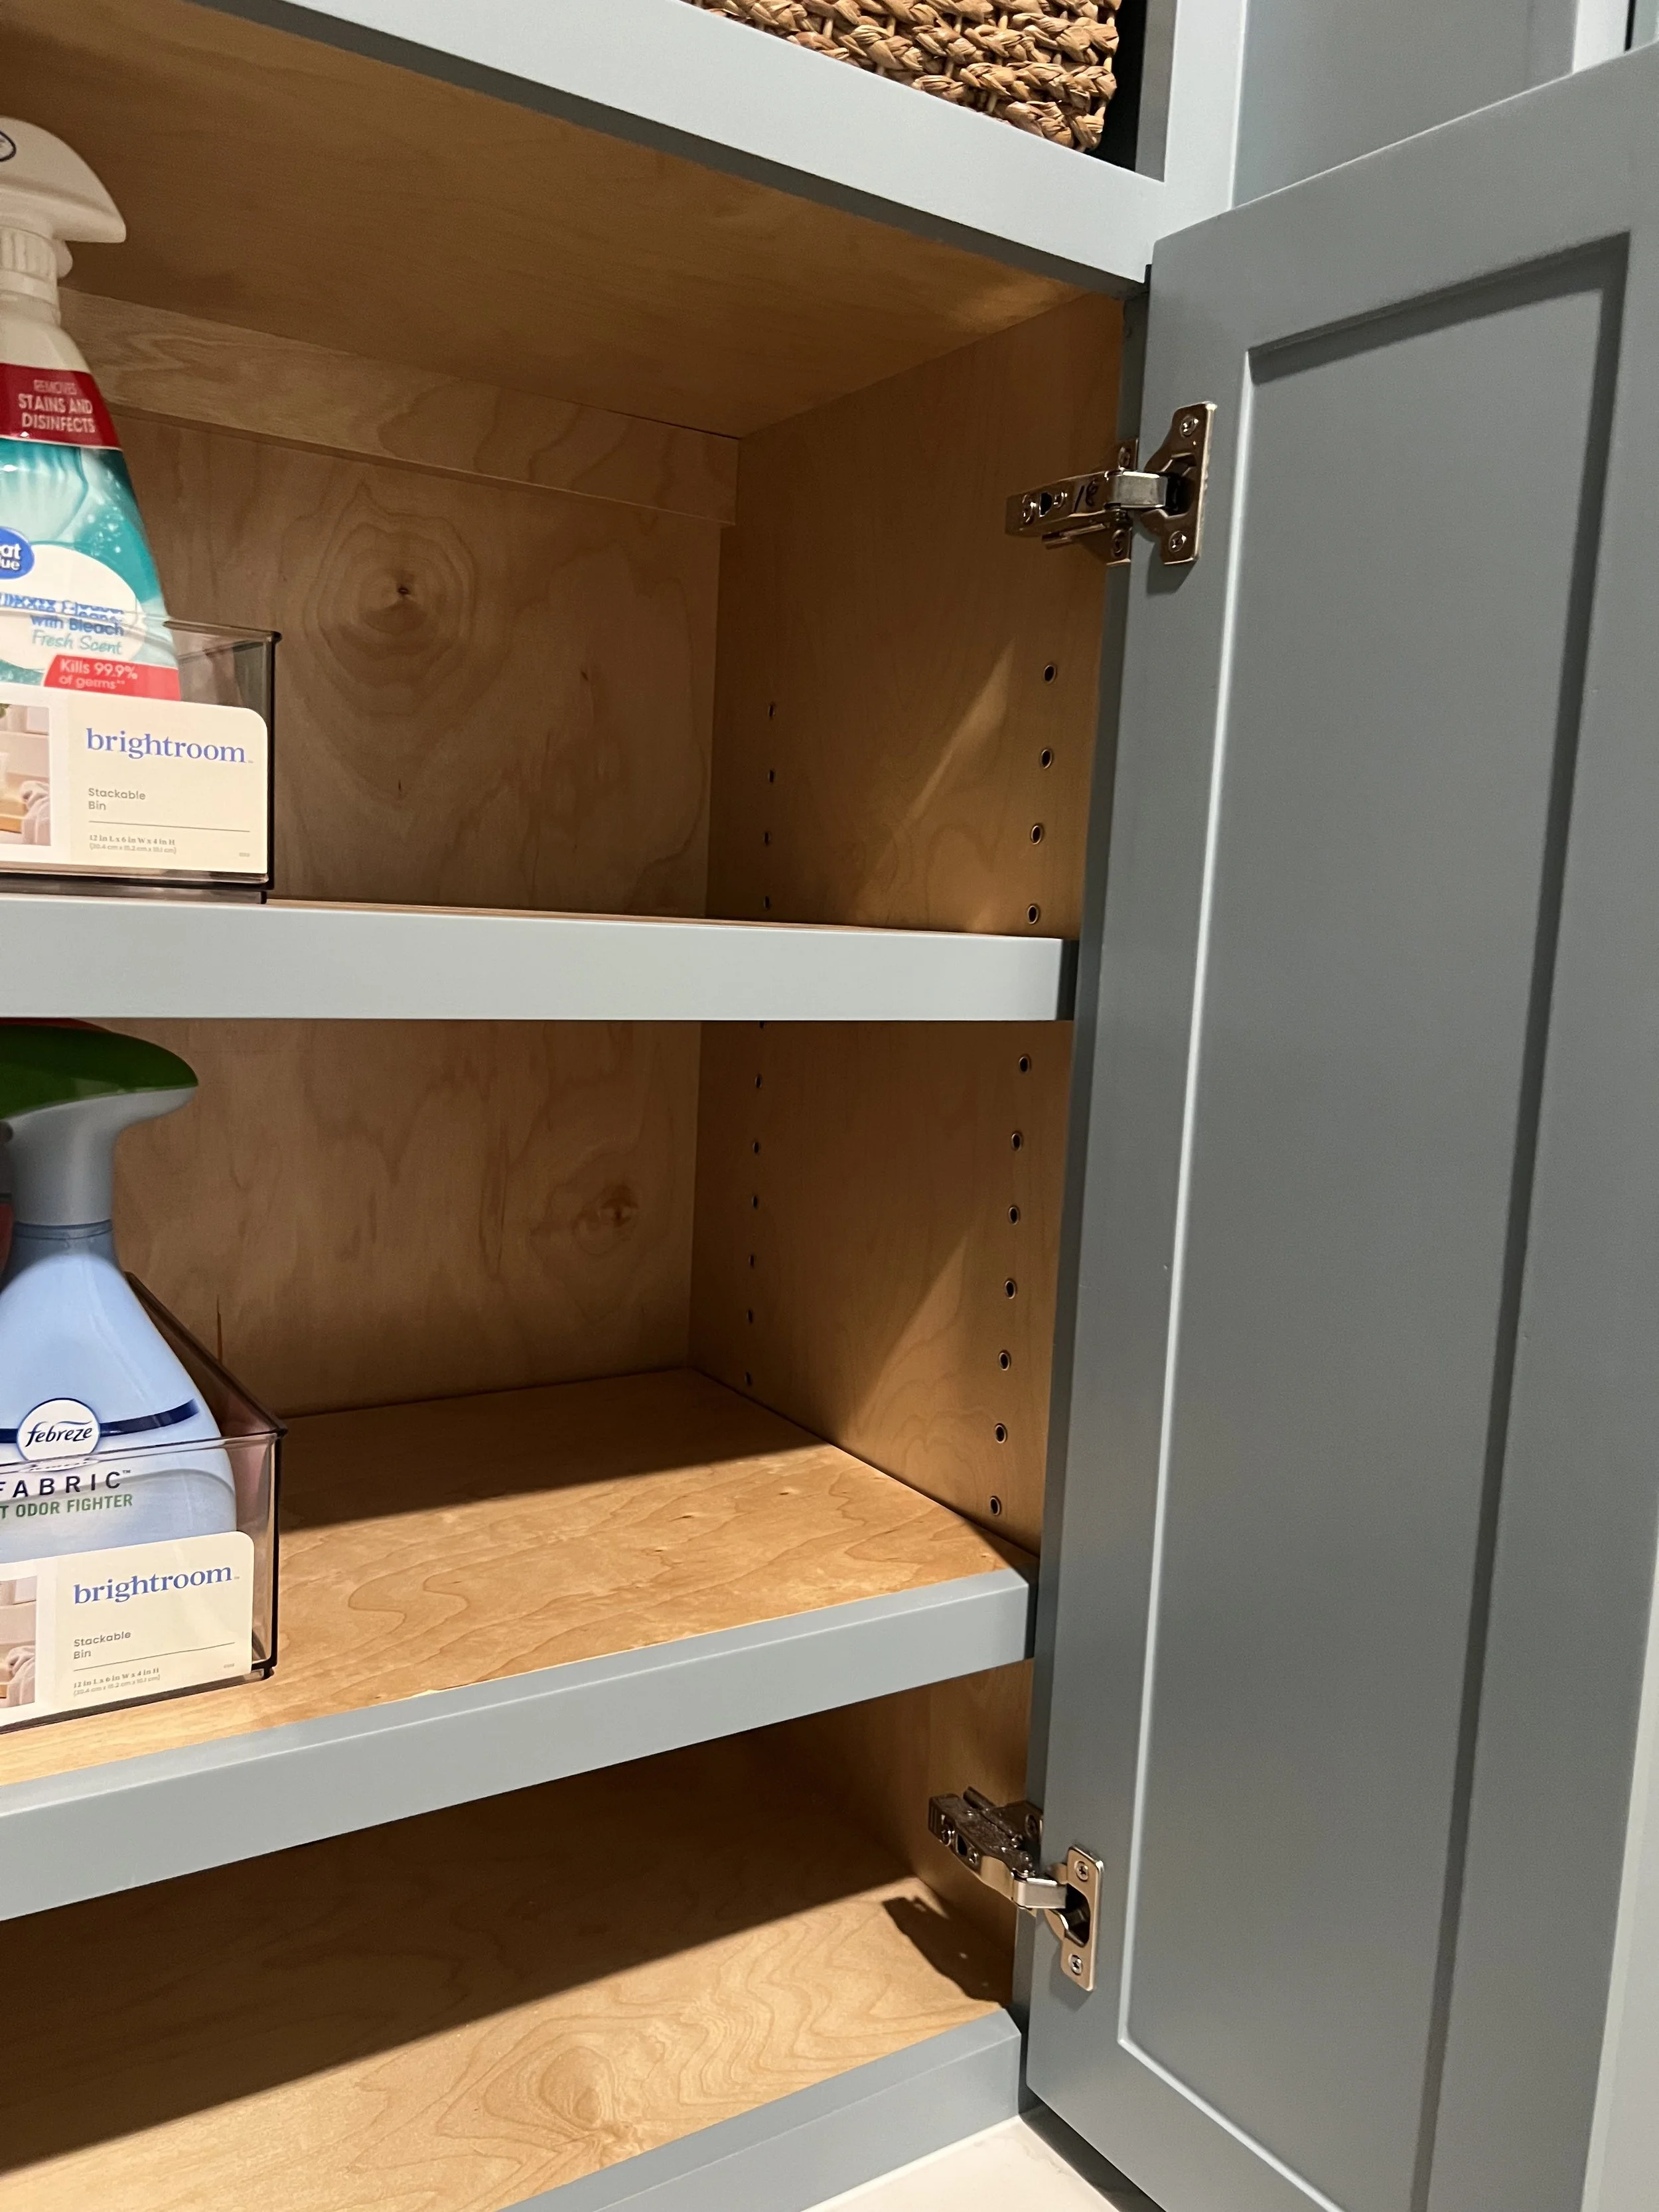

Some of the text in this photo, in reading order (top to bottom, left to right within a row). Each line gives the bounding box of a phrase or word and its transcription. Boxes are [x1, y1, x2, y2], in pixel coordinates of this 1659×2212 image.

[19, 393, 93, 414] STAINS AND
[22, 412, 96, 433] DISINFECTS
[69, 618, 123, 636] Bleach
[32, 630, 122, 655] Fresh Scent
[60, 658, 138, 680] Kills 99.9%
[58, 674, 73, 686] of
[86, 727, 247, 763] brightroom
[88, 788, 146, 800] Stackable
[88, 800, 106, 811] Bin
[25, 1421, 92, 1447] febreze
[16, 1501, 60, 1518] ODOR
[67, 1493, 133, 1513] FIGHTER
[74, 1566, 232, 1605] brightroom
[74, 1631, 131, 1647] Stackable
[74, 1649, 91, 1659] Bin
